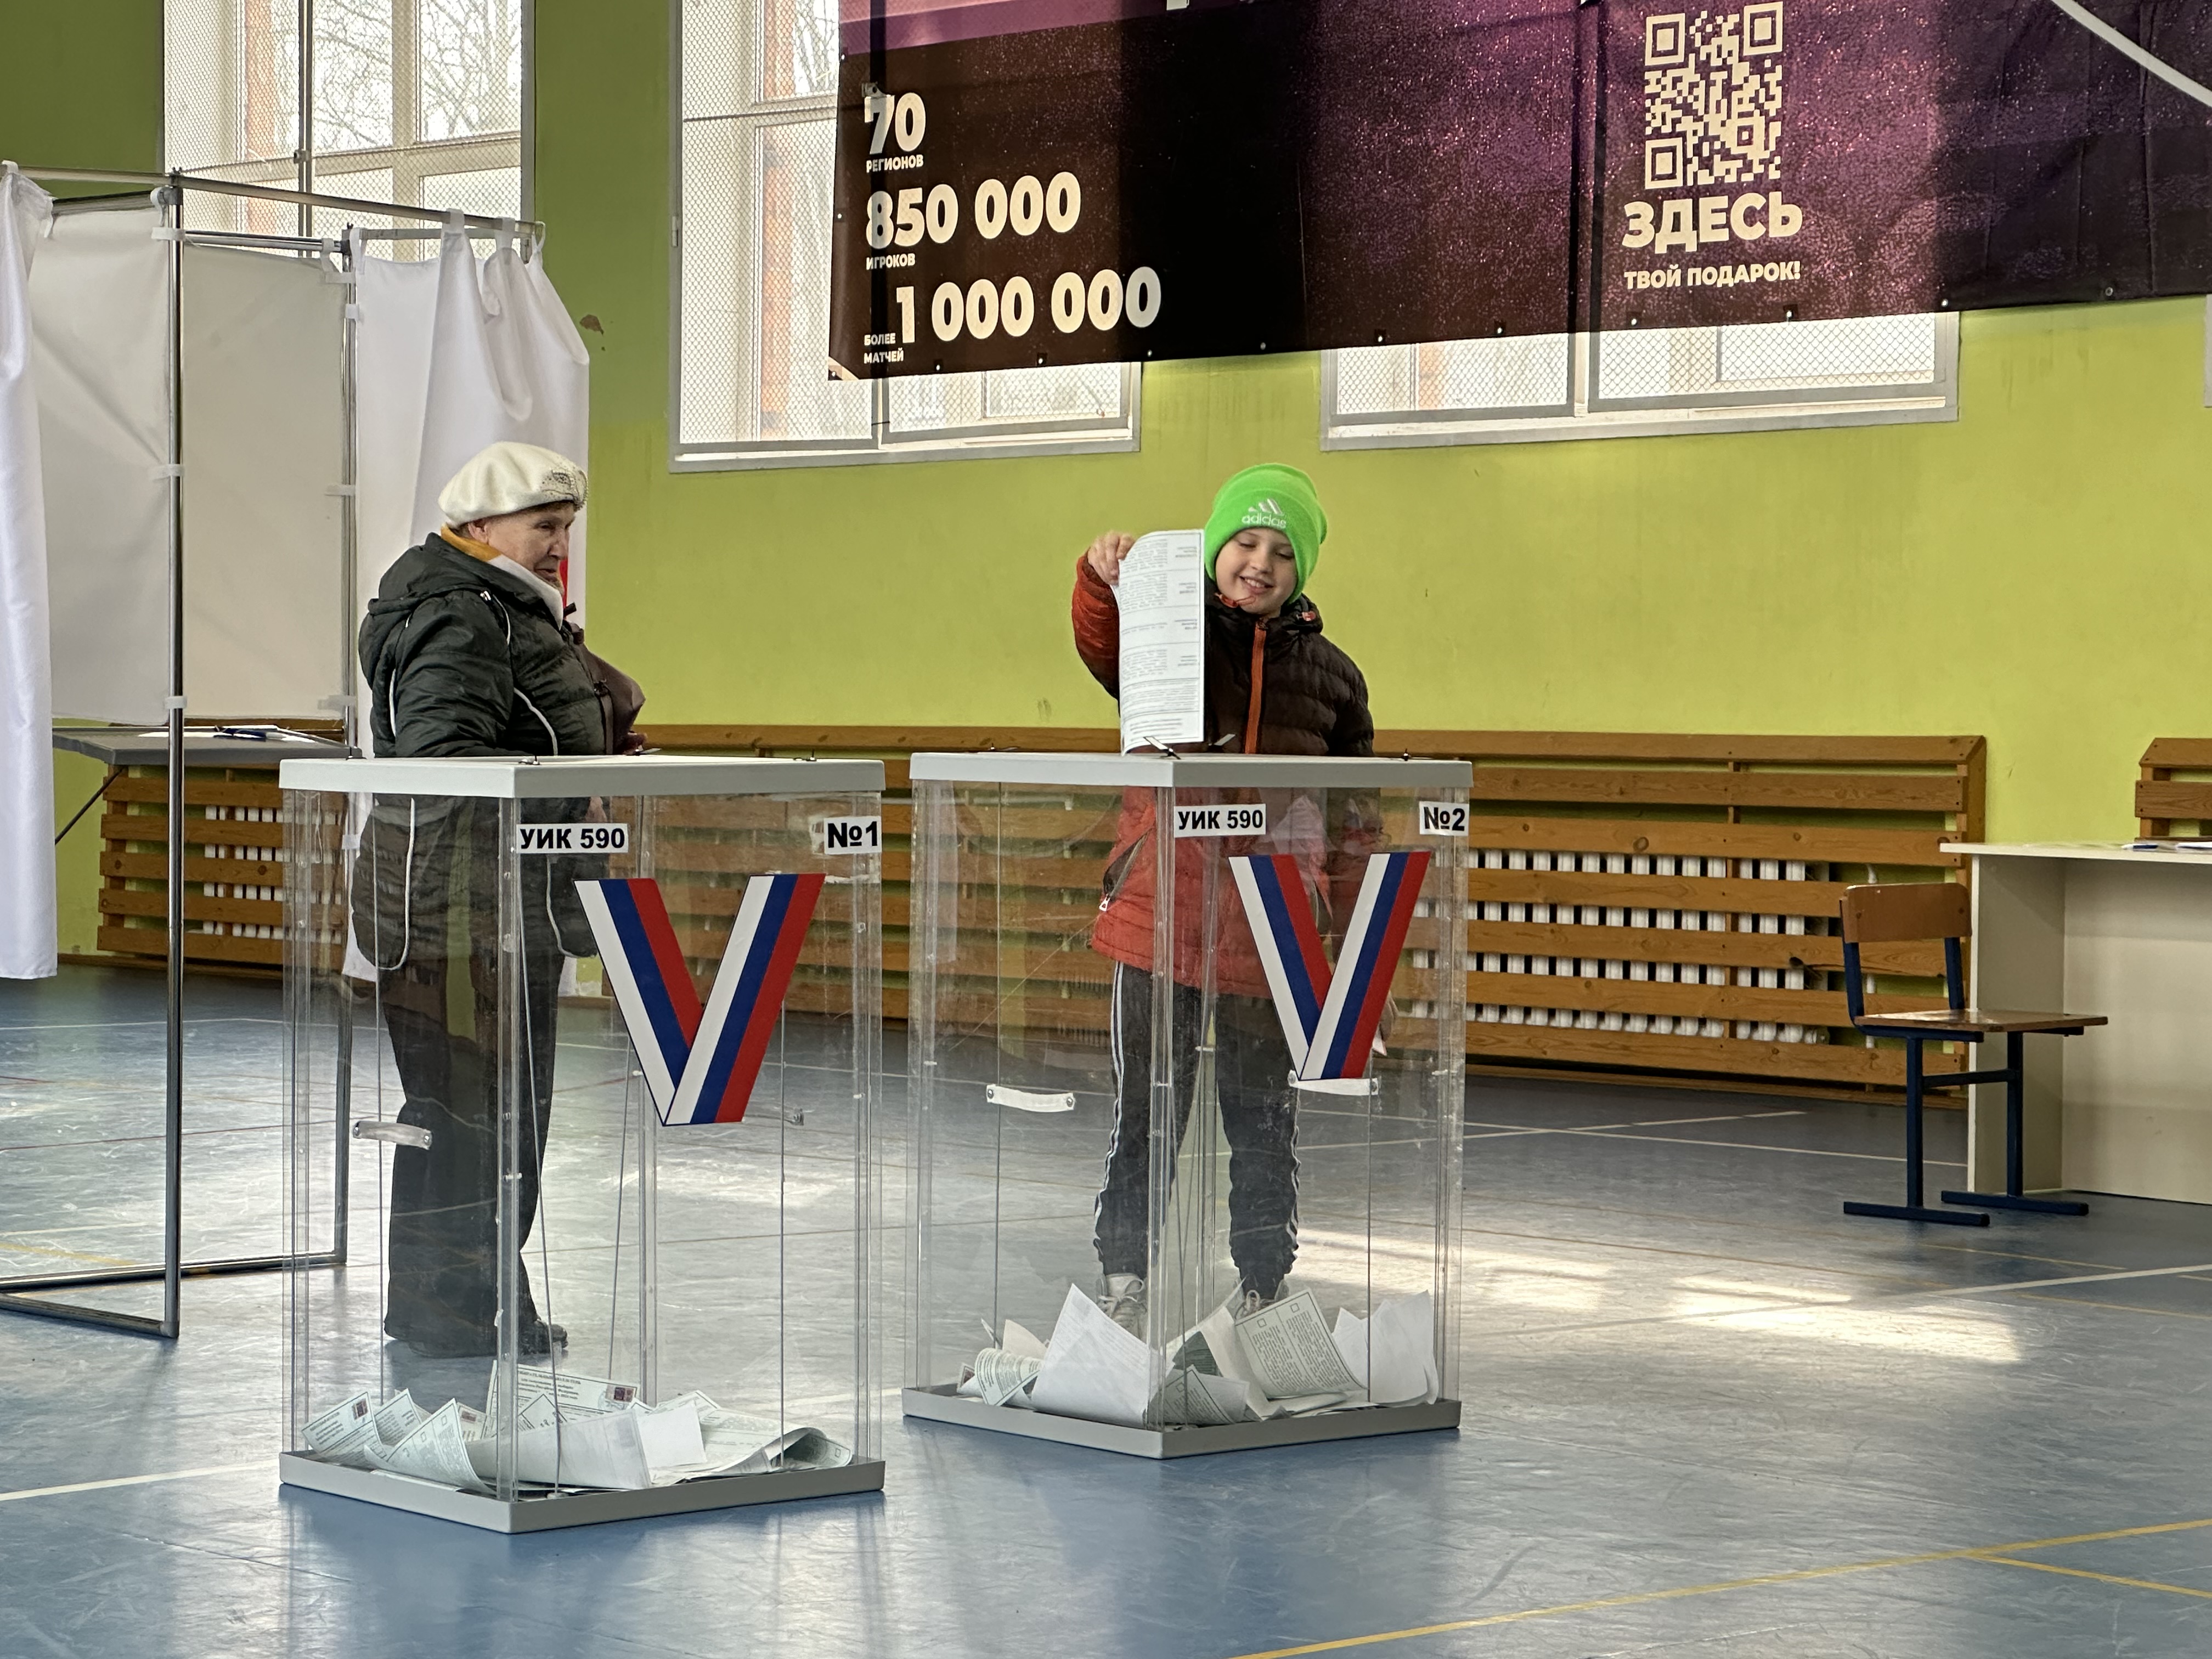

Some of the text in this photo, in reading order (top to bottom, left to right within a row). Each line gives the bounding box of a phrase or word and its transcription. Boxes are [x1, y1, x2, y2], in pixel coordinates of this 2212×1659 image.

[864, 92, 926, 155] 70
[866, 154, 924, 173] РЕГИОНОВ
[866, 171, 1081, 250] 850 000
[1622, 191, 1803, 255] ЗДЕСЬ
[866, 253, 916, 270] ИГРОКОВ
[1624, 261, 1801, 290] ТВОЙ ПОДАРОК!
[896, 266, 1162, 344] 1 000 000
[864, 332, 896, 346] БОЛЕЕ
[864, 347, 904, 364] МАТЧЕЙ
[1241, 512, 1287, 529] adidas
[1177, 809, 1263, 830] УИК 590
[1423, 806, 1466, 832] №2
[520, 827, 625, 849] УИК 590
[827, 821, 878, 848] №1
